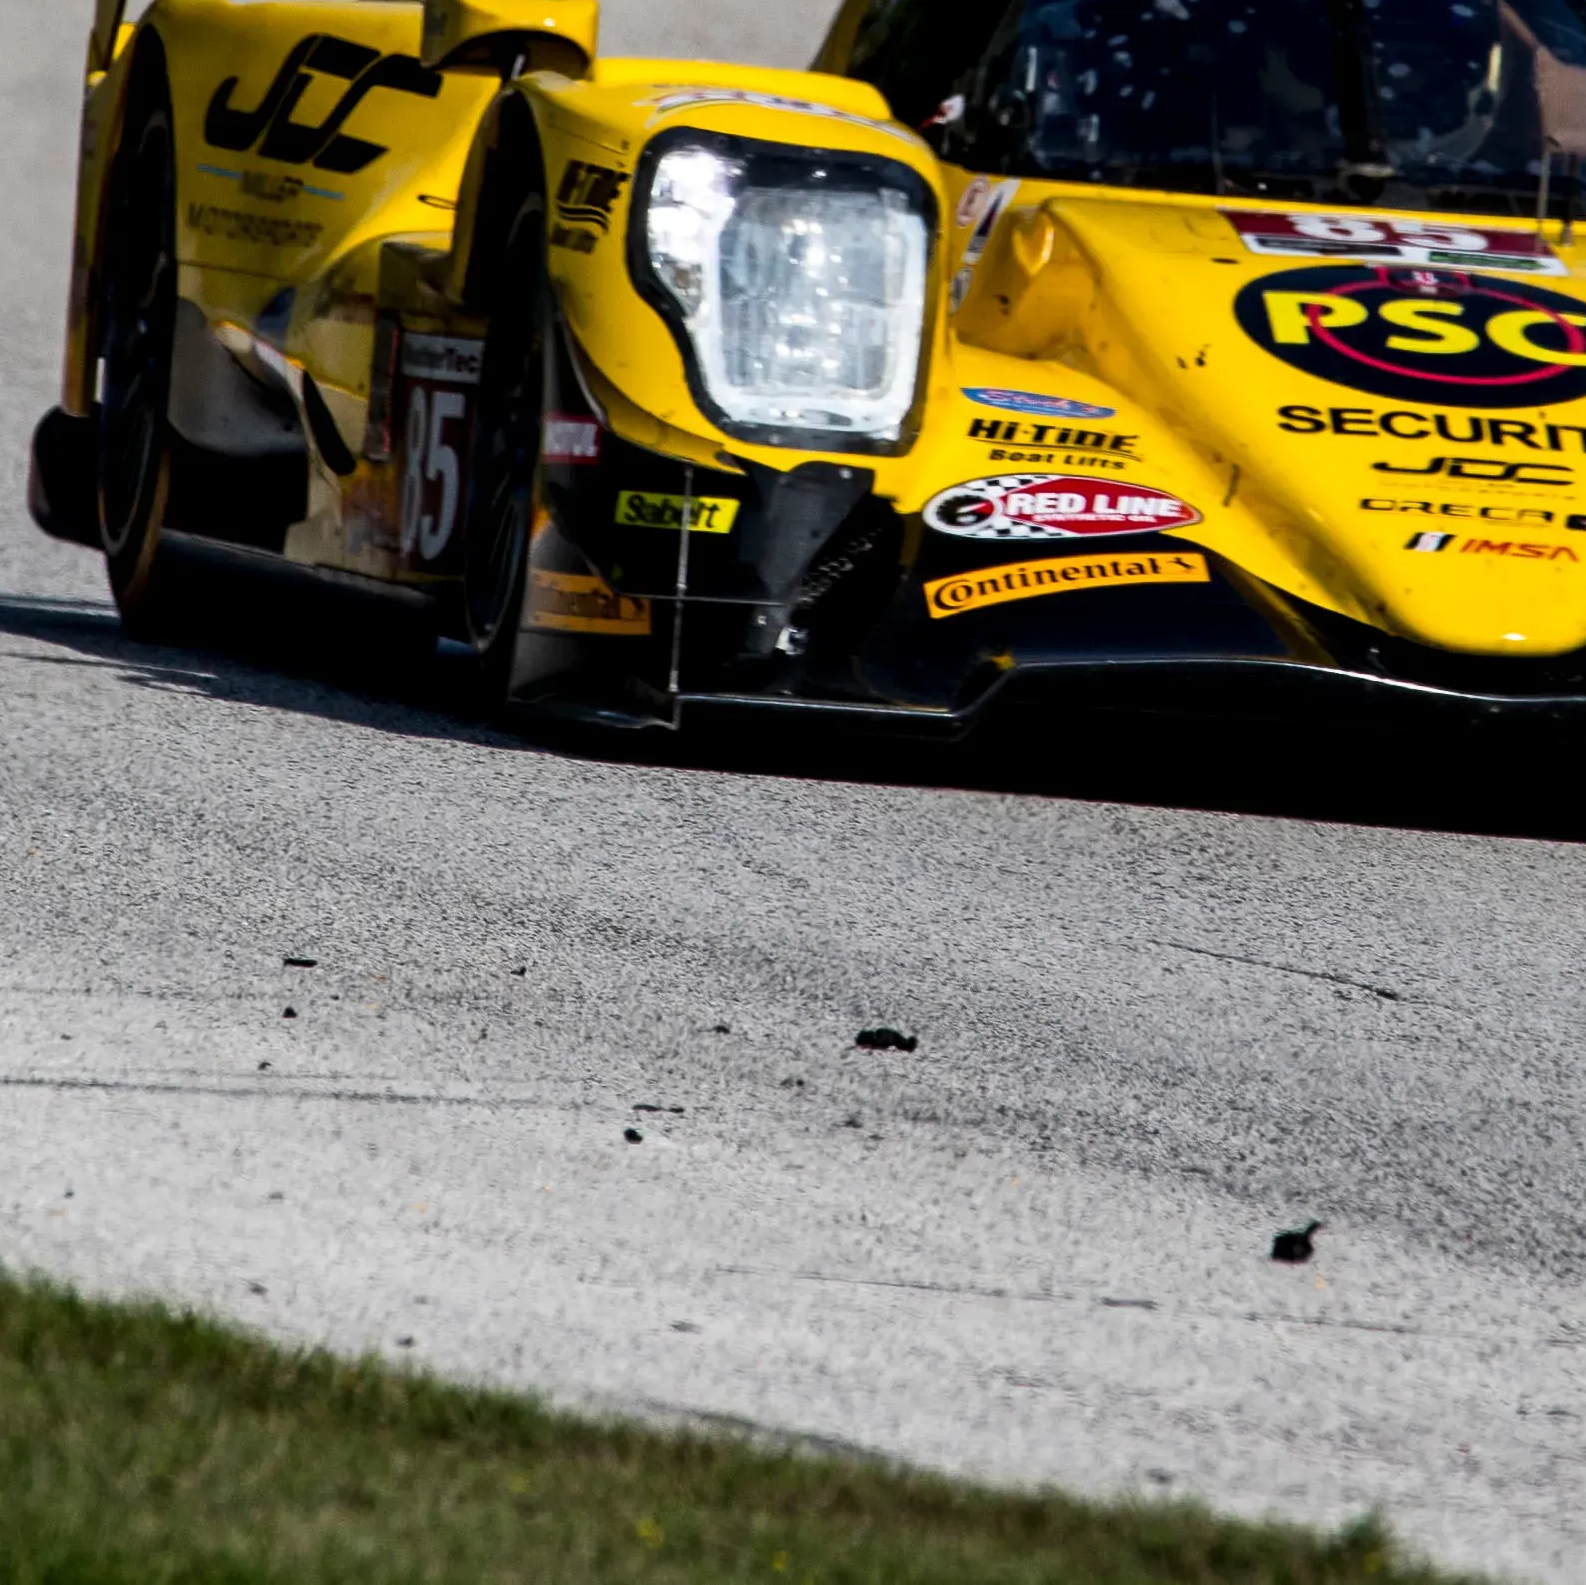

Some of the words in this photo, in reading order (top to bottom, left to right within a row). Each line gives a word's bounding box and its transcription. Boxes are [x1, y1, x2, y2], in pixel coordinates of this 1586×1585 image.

[1290, 214, 1489, 252] 85
[1370, 456, 1576, 487] JDC
[1007, 492, 1087, 515] RED
[1092, 493, 1189, 518] LINE
[1358, 497, 1555, 525] ORECA
[1459, 538, 1581, 563] IMSA
[932, 557, 1163, 611] Continental
